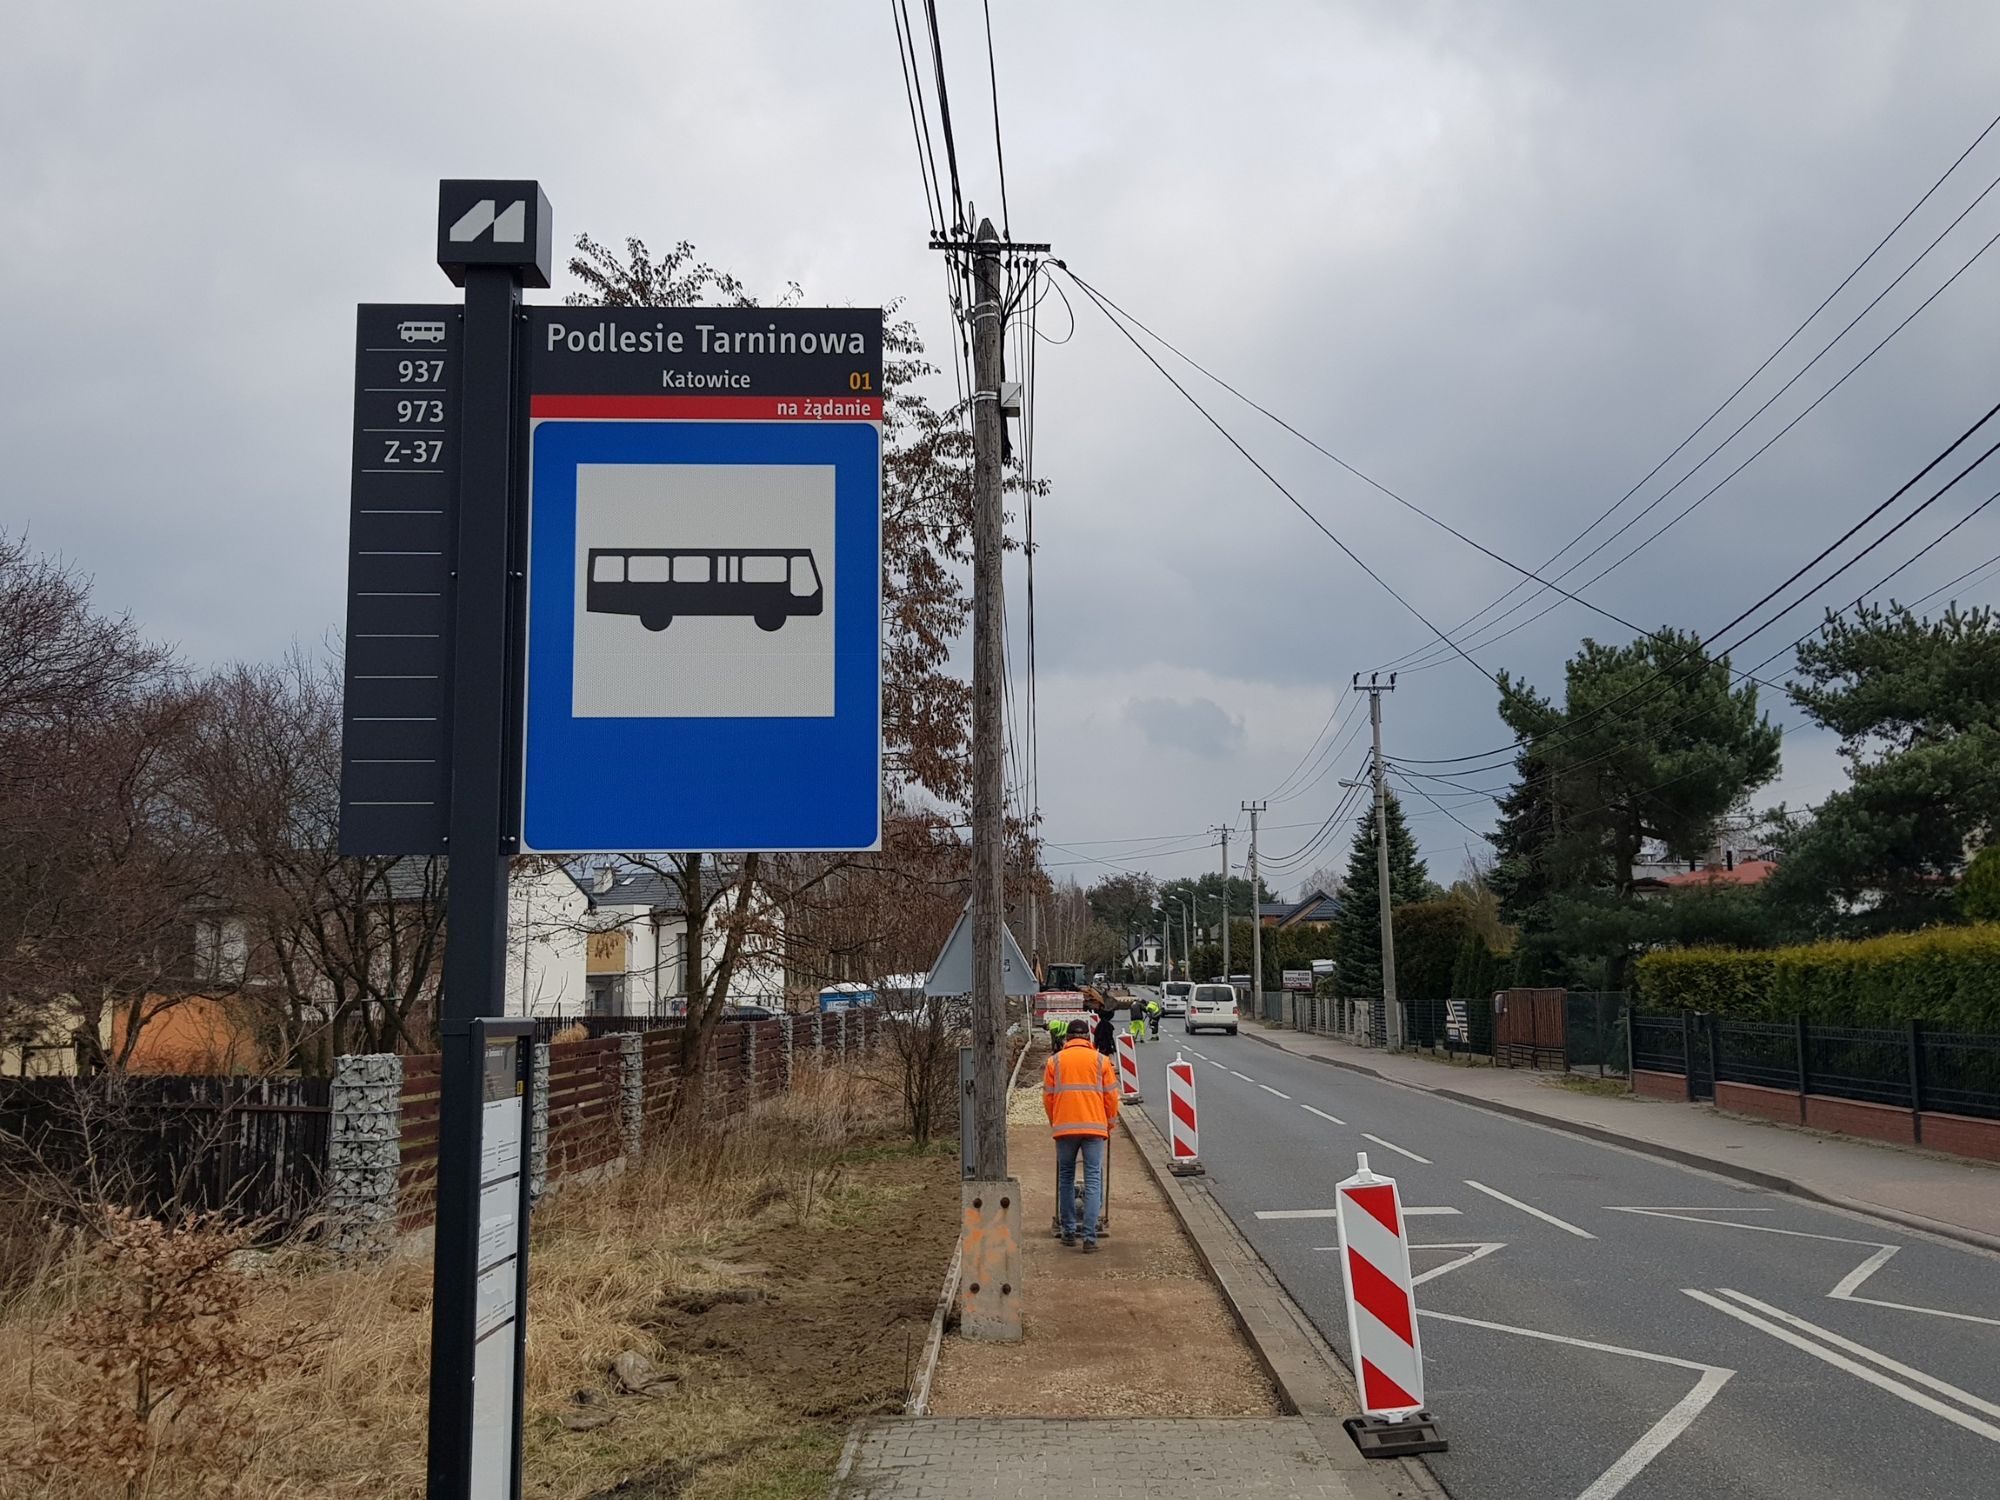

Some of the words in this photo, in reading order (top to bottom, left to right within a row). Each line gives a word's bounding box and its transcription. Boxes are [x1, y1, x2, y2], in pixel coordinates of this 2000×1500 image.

[548, 322, 684, 353] Podlesie
[695, 323, 865, 354] Tarninowa
[398, 360, 445, 383] 937
[662, 369, 751, 388] Katowice
[849, 372, 872, 390] 01
[397, 400, 444, 423] 973
[777, 403, 798, 416] na
[803, 399, 871, 419] żądanie
[384, 440, 443, 463] Z-37
